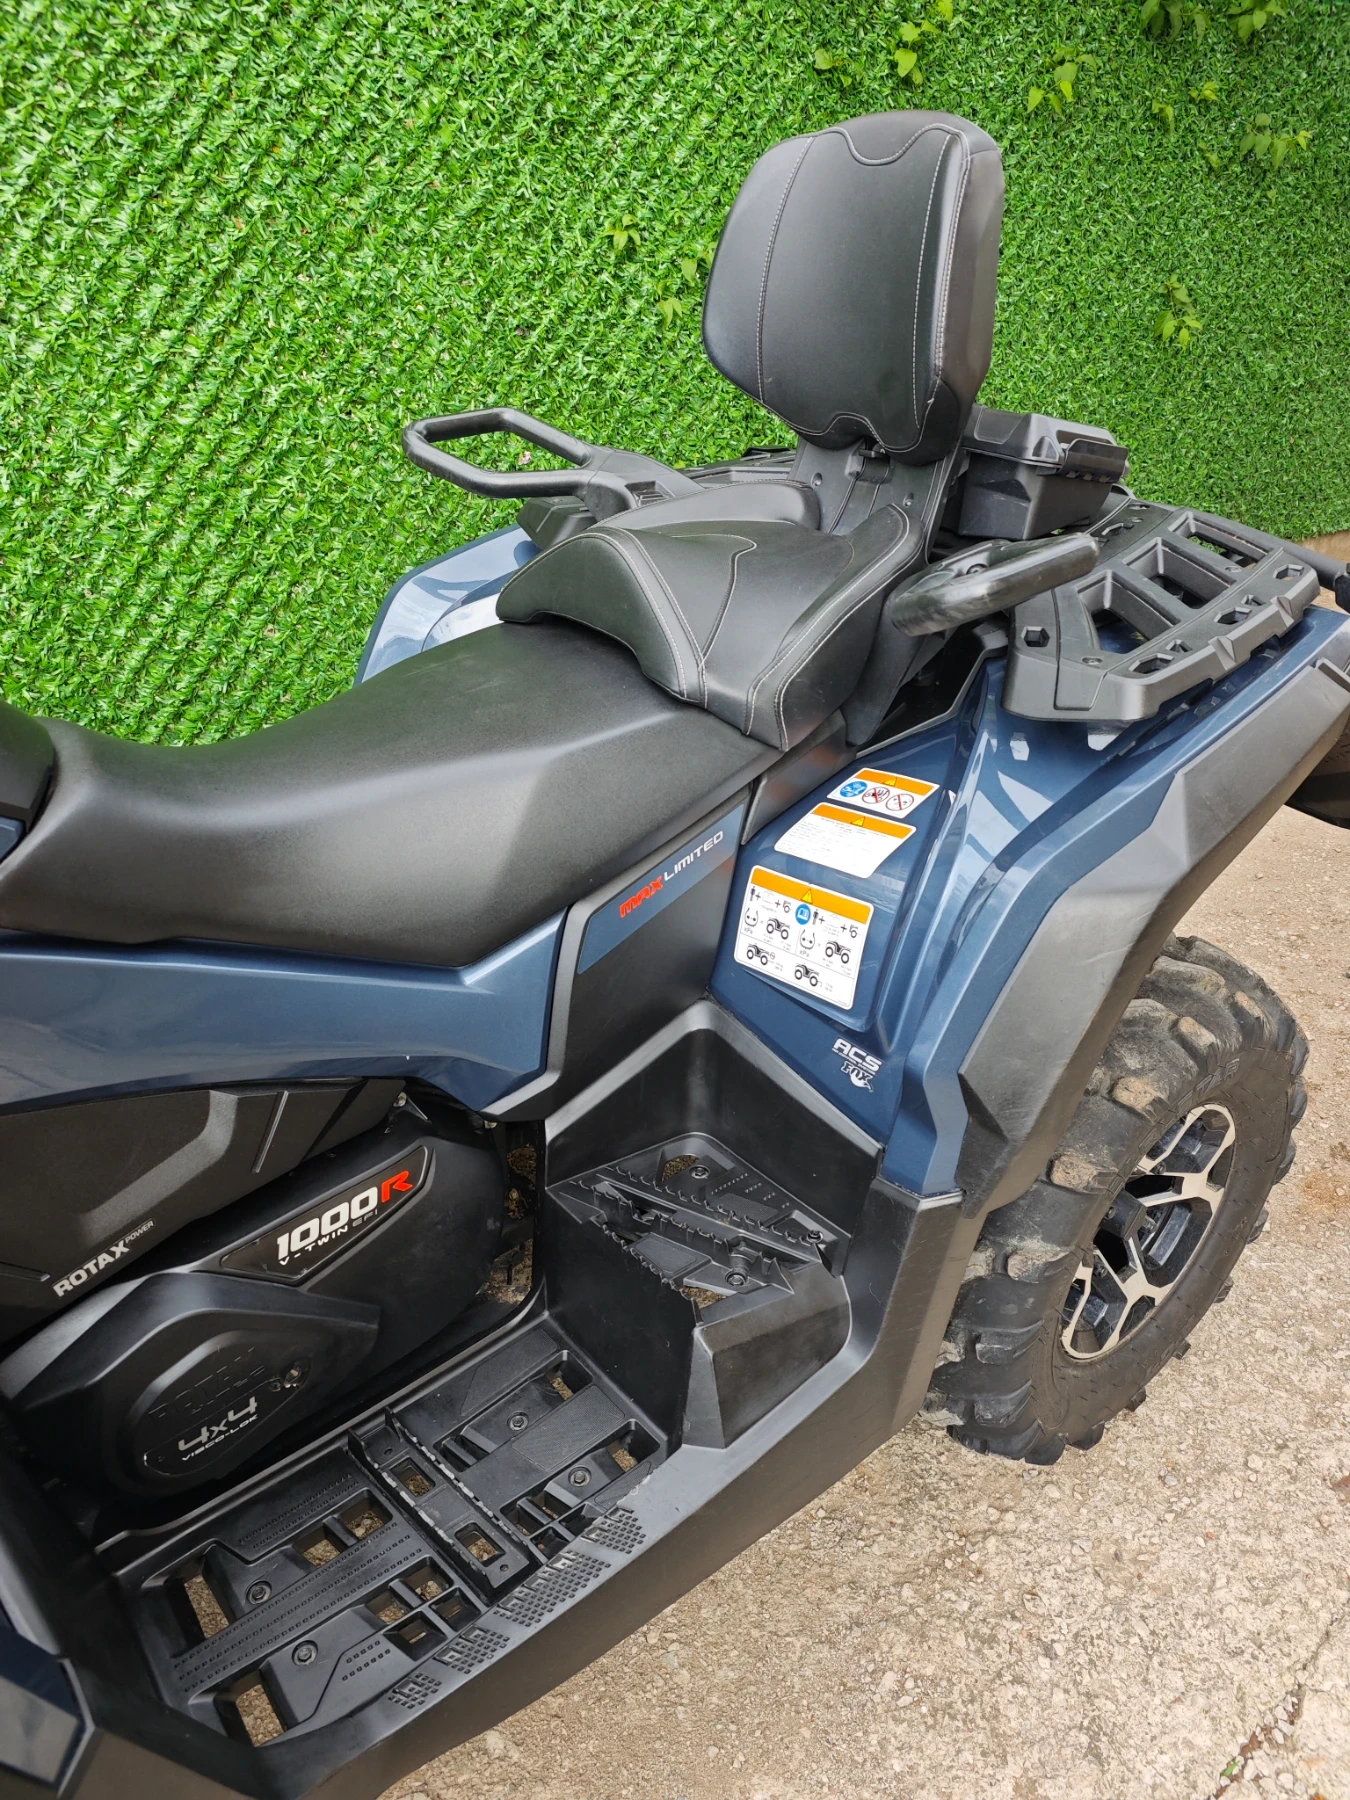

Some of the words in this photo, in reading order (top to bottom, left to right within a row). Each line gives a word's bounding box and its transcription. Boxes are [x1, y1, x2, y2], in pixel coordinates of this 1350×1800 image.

[619, 875, 664, 918] MAX
[664, 830, 724, 882] LIMITED
[833, 1038, 883, 1072] ACS
[841, 1061, 874, 1083] FOX
[52, 1239, 130, 1298] ROTAX
[125, 1220, 155, 1244] POWER
[279, 1225, 349, 1267] V-TWIN
[352, 1209, 378, 1228] EFI
[177, 1396, 258, 1452] 4x4
[182, 1414, 258, 1462] VISCO-LOK
